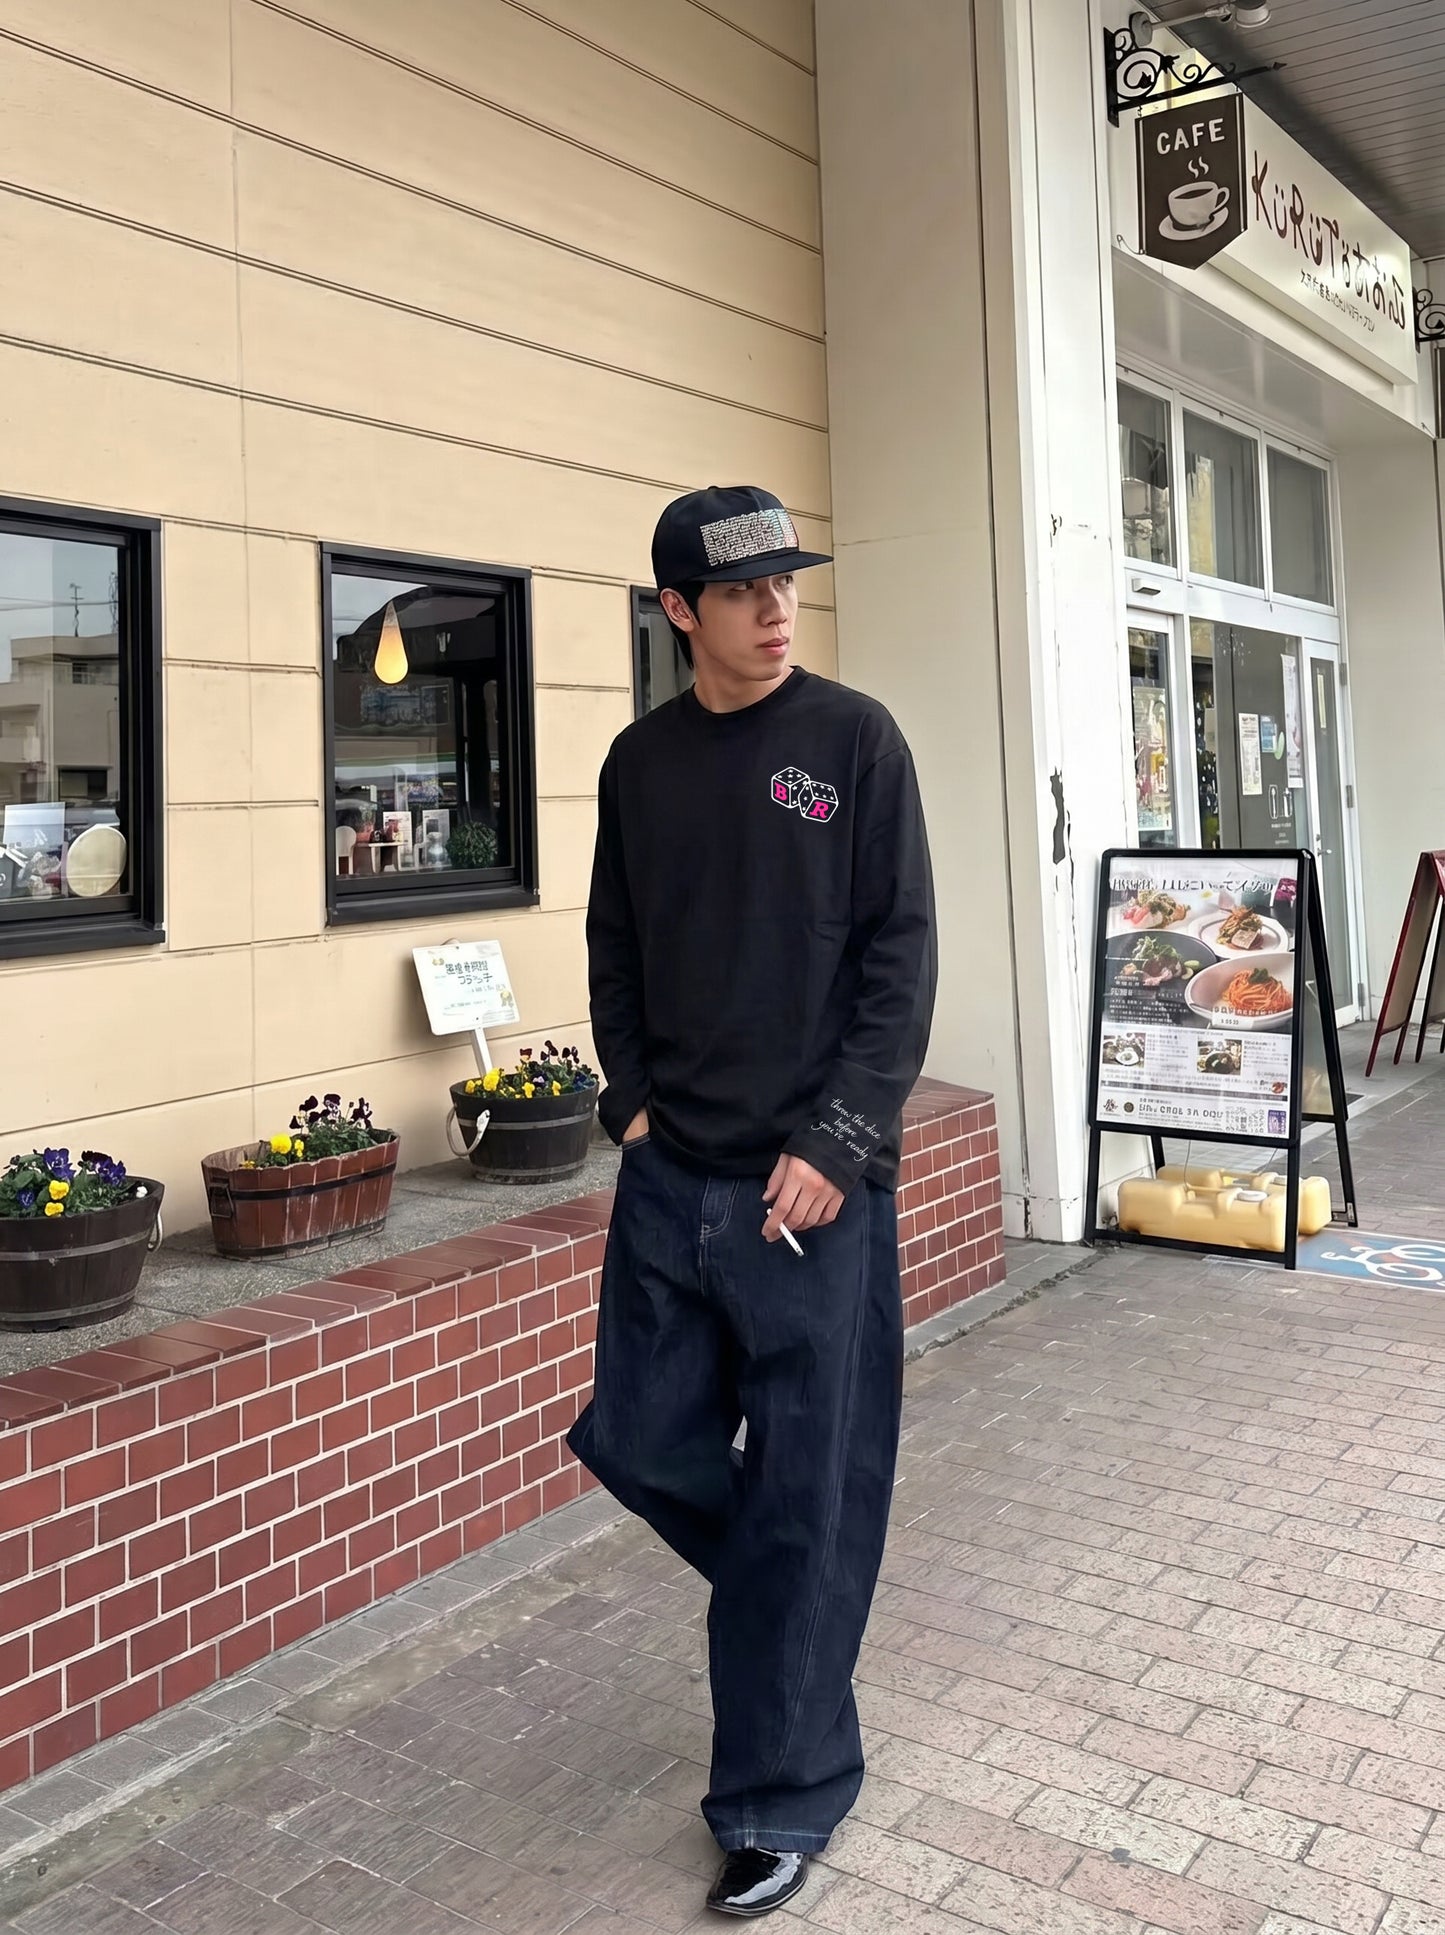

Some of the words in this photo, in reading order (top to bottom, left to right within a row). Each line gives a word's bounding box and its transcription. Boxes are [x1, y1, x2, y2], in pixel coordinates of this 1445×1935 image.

[1156, 117, 1226, 156] CAFE
[774, 781, 787, 801] B
[809, 801, 829, 819] R
[830, 1098, 852, 1117] throw
[851, 1113, 866, 1128] the
[865, 1123, 881, 1140] dice
[833, 1117, 858, 1138] before
[811, 1121, 845, 1141] you're
[846, 1140, 869, 1162] ready
